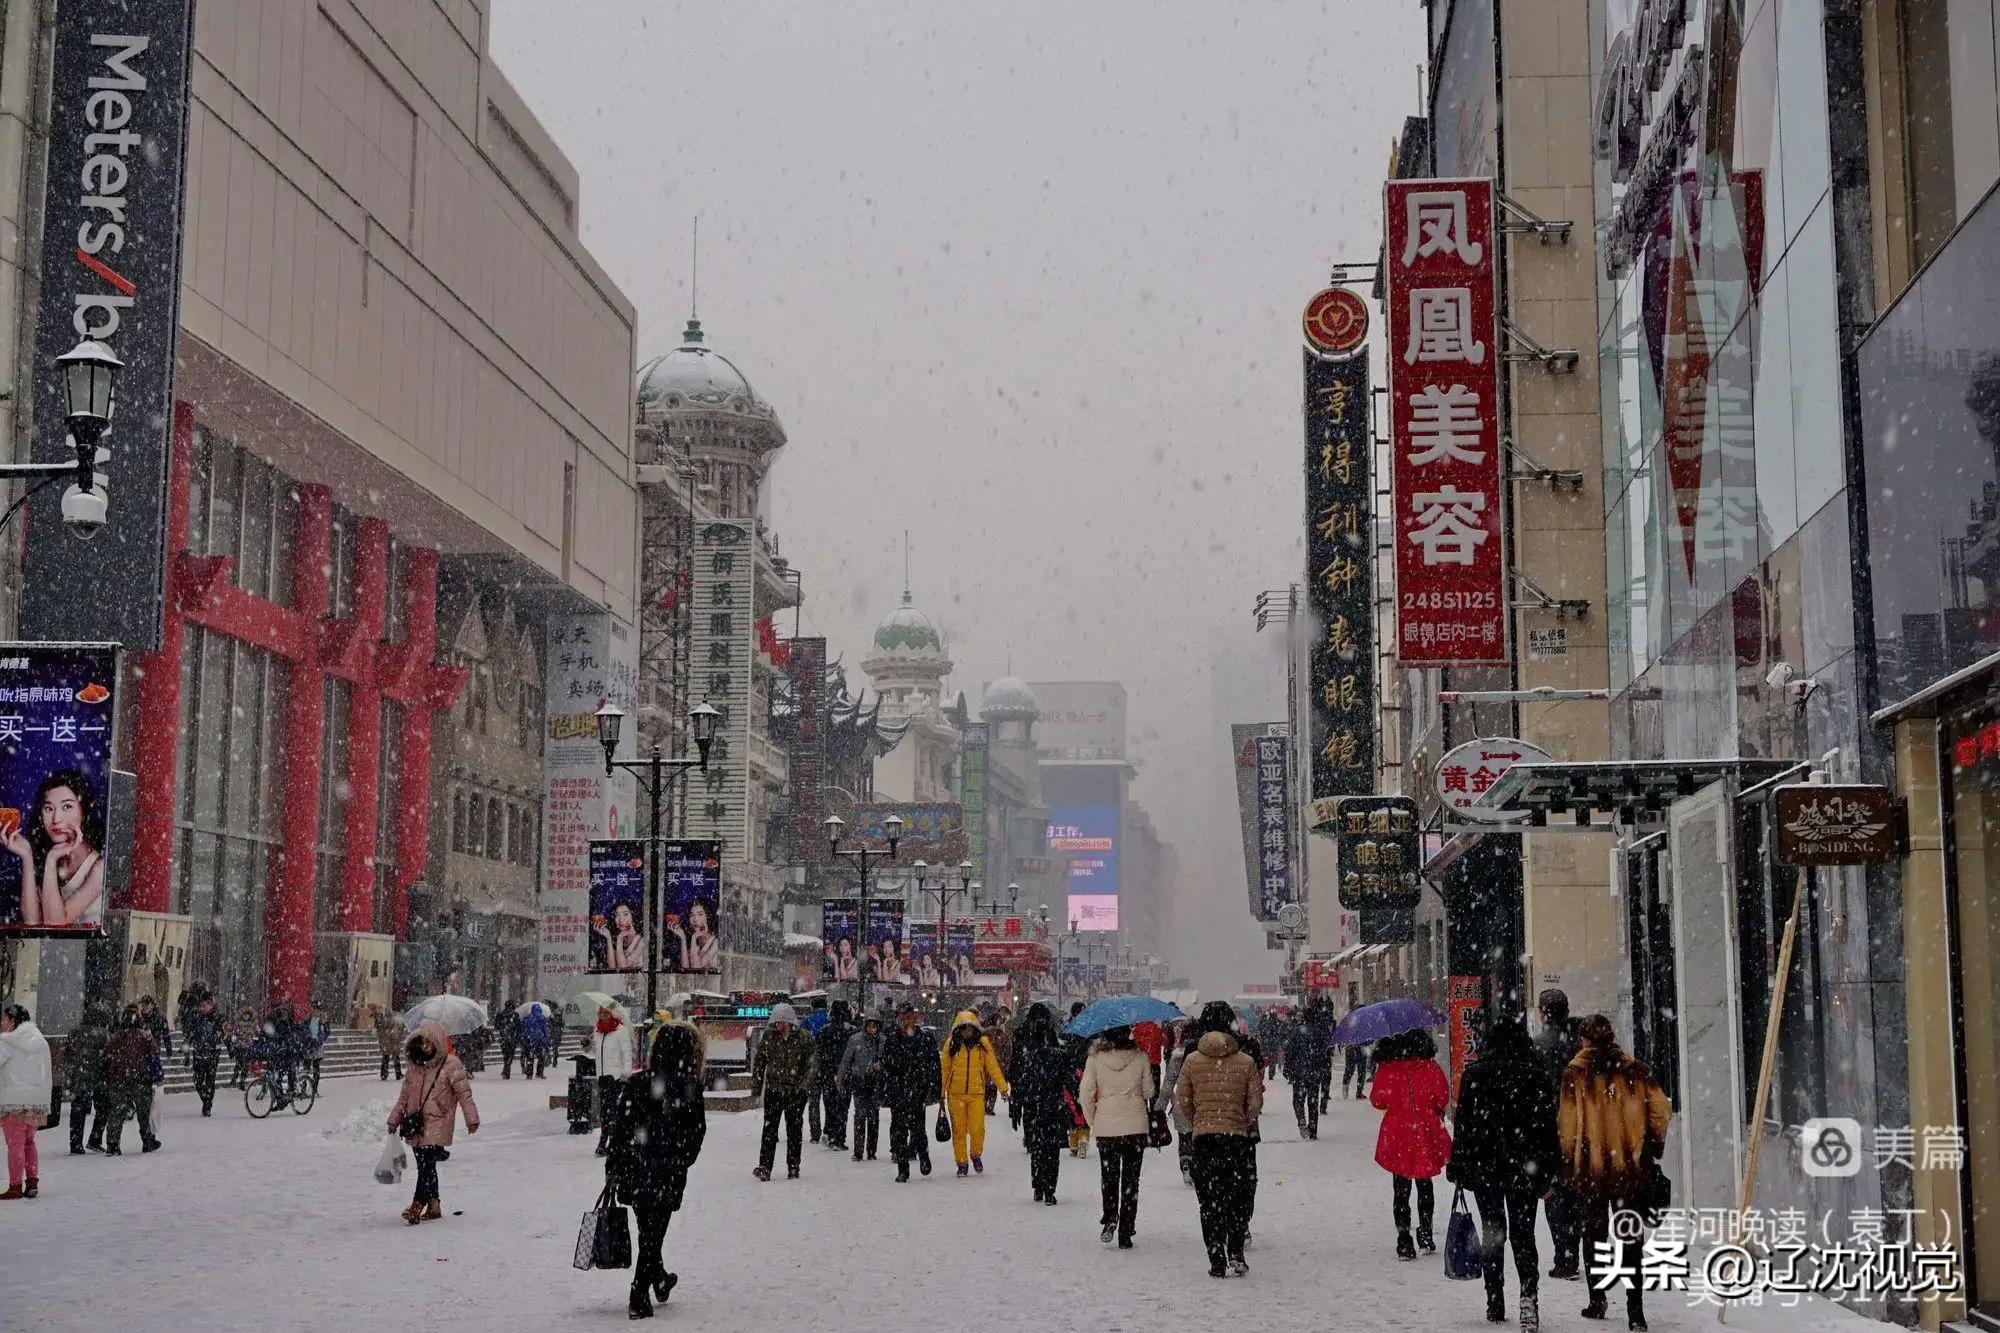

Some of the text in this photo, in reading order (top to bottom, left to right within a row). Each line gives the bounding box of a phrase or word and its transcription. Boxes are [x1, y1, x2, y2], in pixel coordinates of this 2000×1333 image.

[1402, 191, 1490, 567] 凤凰美容
[1315, 379, 1364, 770] 亨得利钟表眼镜
[1403, 592, 1496, 610] 24851125
[1404, 622, 1496, 642] 眼镜店内二楼
[0, 715, 105, 742] 买一送一
[1442, 765, 1508, 794] 黄金
[1260, 740, 1288, 916] 欧亚名表维修中心
[1799, 841, 1874, 854] BOSIDENG
